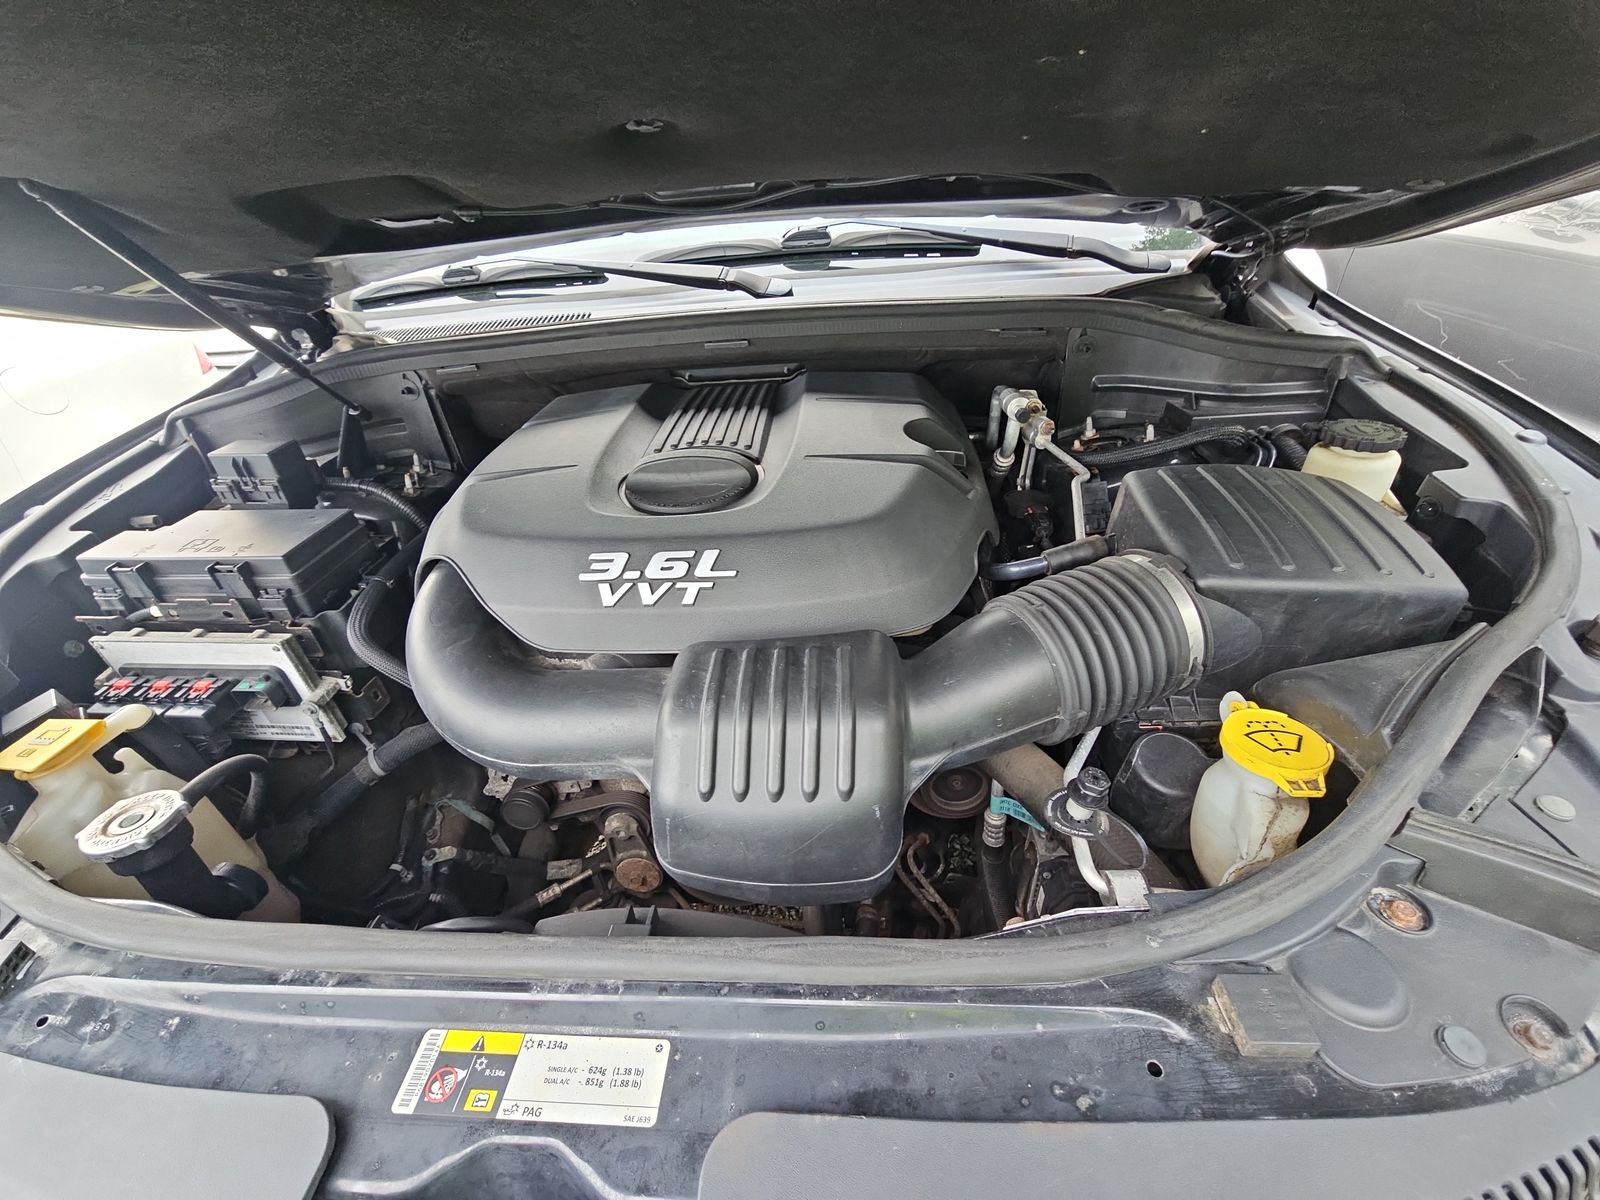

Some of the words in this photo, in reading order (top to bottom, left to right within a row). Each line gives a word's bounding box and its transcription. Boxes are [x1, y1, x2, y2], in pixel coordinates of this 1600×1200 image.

[578, 549, 739, 581] 3.6L
[598, 581, 715, 607] VVT
[536, 1039, 568, 1050] R-134a
[484, 1068, 506, 1077] R-134a
[567, 1066, 578, 1074] A/C
[588, 1066, 607, 1077] 624g
[612, 1066, 632, 1077] (1.38
[634, 1067, 645, 1078] lb)
[585, 1077, 604, 1088] 851g
[609, 1078, 630, 1089] (1.88
[631, 1079, 642, 1090] lb)
[522, 1106, 543, 1118] PAG
[623, 1114, 635, 1123] SAE
[635, 1115, 651, 1124] J639
